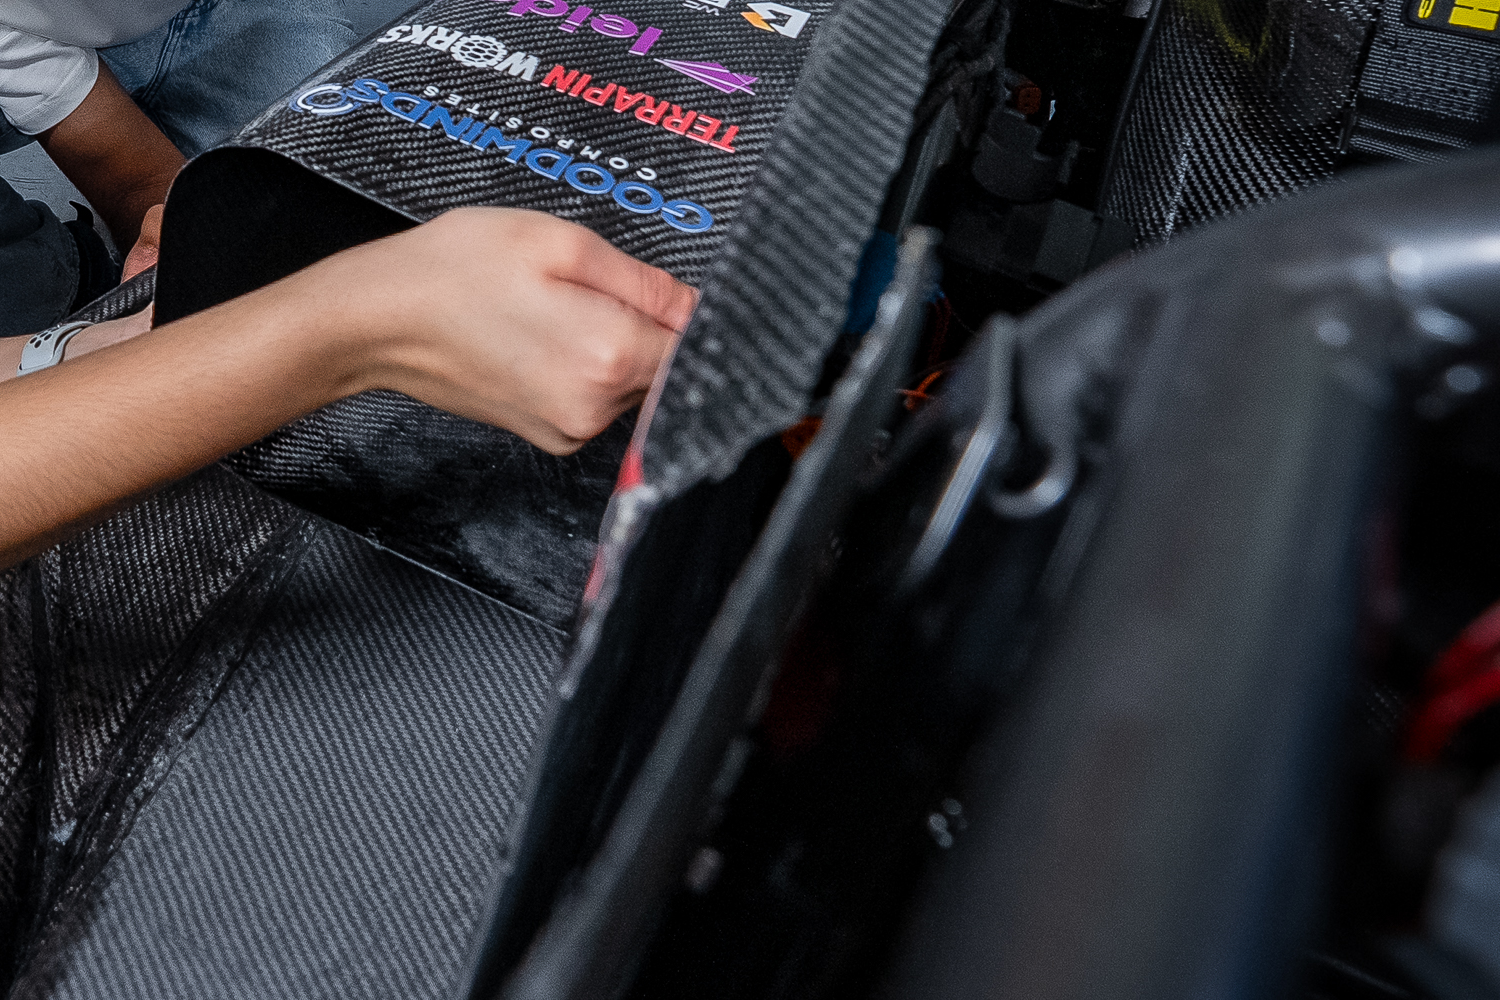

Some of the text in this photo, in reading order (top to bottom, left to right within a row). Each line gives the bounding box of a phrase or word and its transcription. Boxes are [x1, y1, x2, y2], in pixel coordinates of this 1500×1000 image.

[682, 1, 721, 16] WC
[376, 24, 740, 153] TERRAPIN WORKS
[423, 84, 659, 182] COMPOSITES
[344, 77, 714, 233] GOODWINDS
